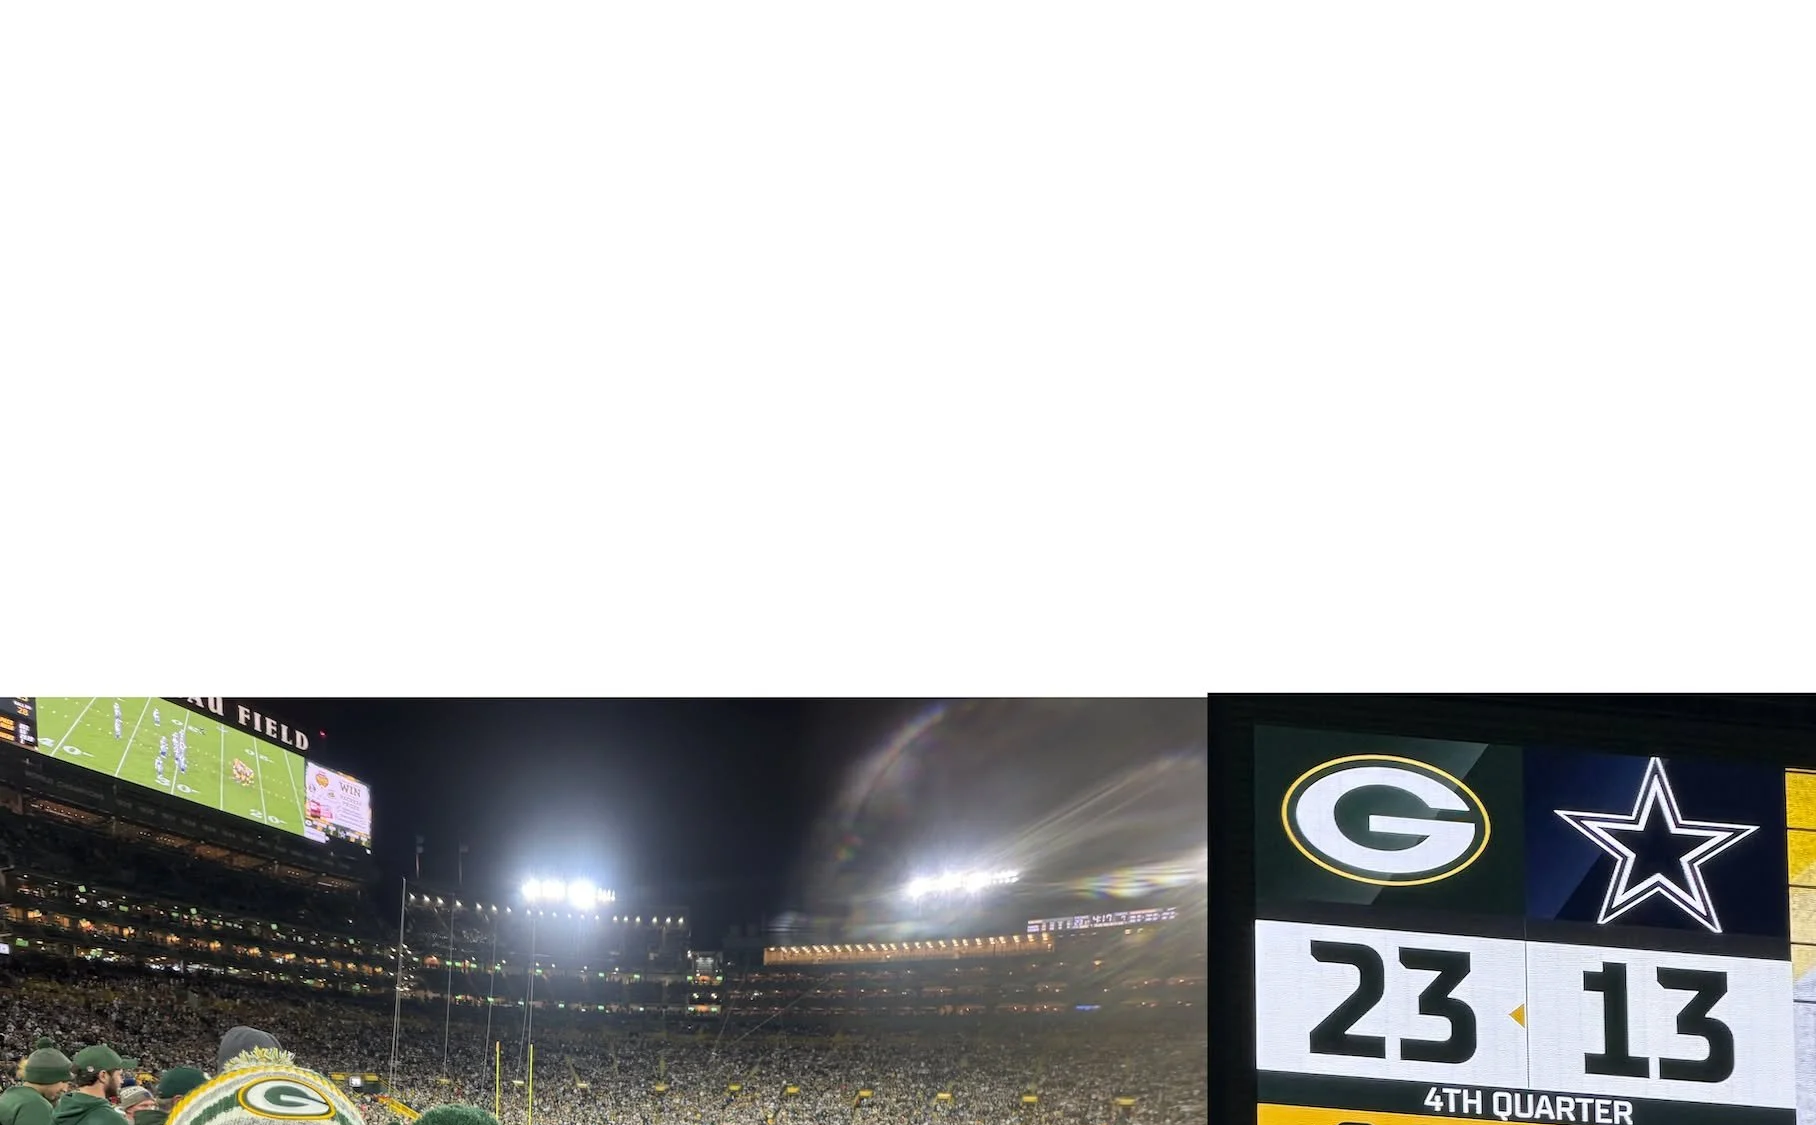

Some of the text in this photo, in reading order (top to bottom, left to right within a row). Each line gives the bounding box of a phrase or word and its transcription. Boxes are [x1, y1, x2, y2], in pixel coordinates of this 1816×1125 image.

[237, 704, 310, 751] FIELD
[339, 781, 361, 798] WIN
[1295, 765, 1477, 875] G
[1309, 938, 1735, 1084] 23 13
[246, 1080, 330, 1115] G
[1424, 1086, 1483, 1117] 4TH
